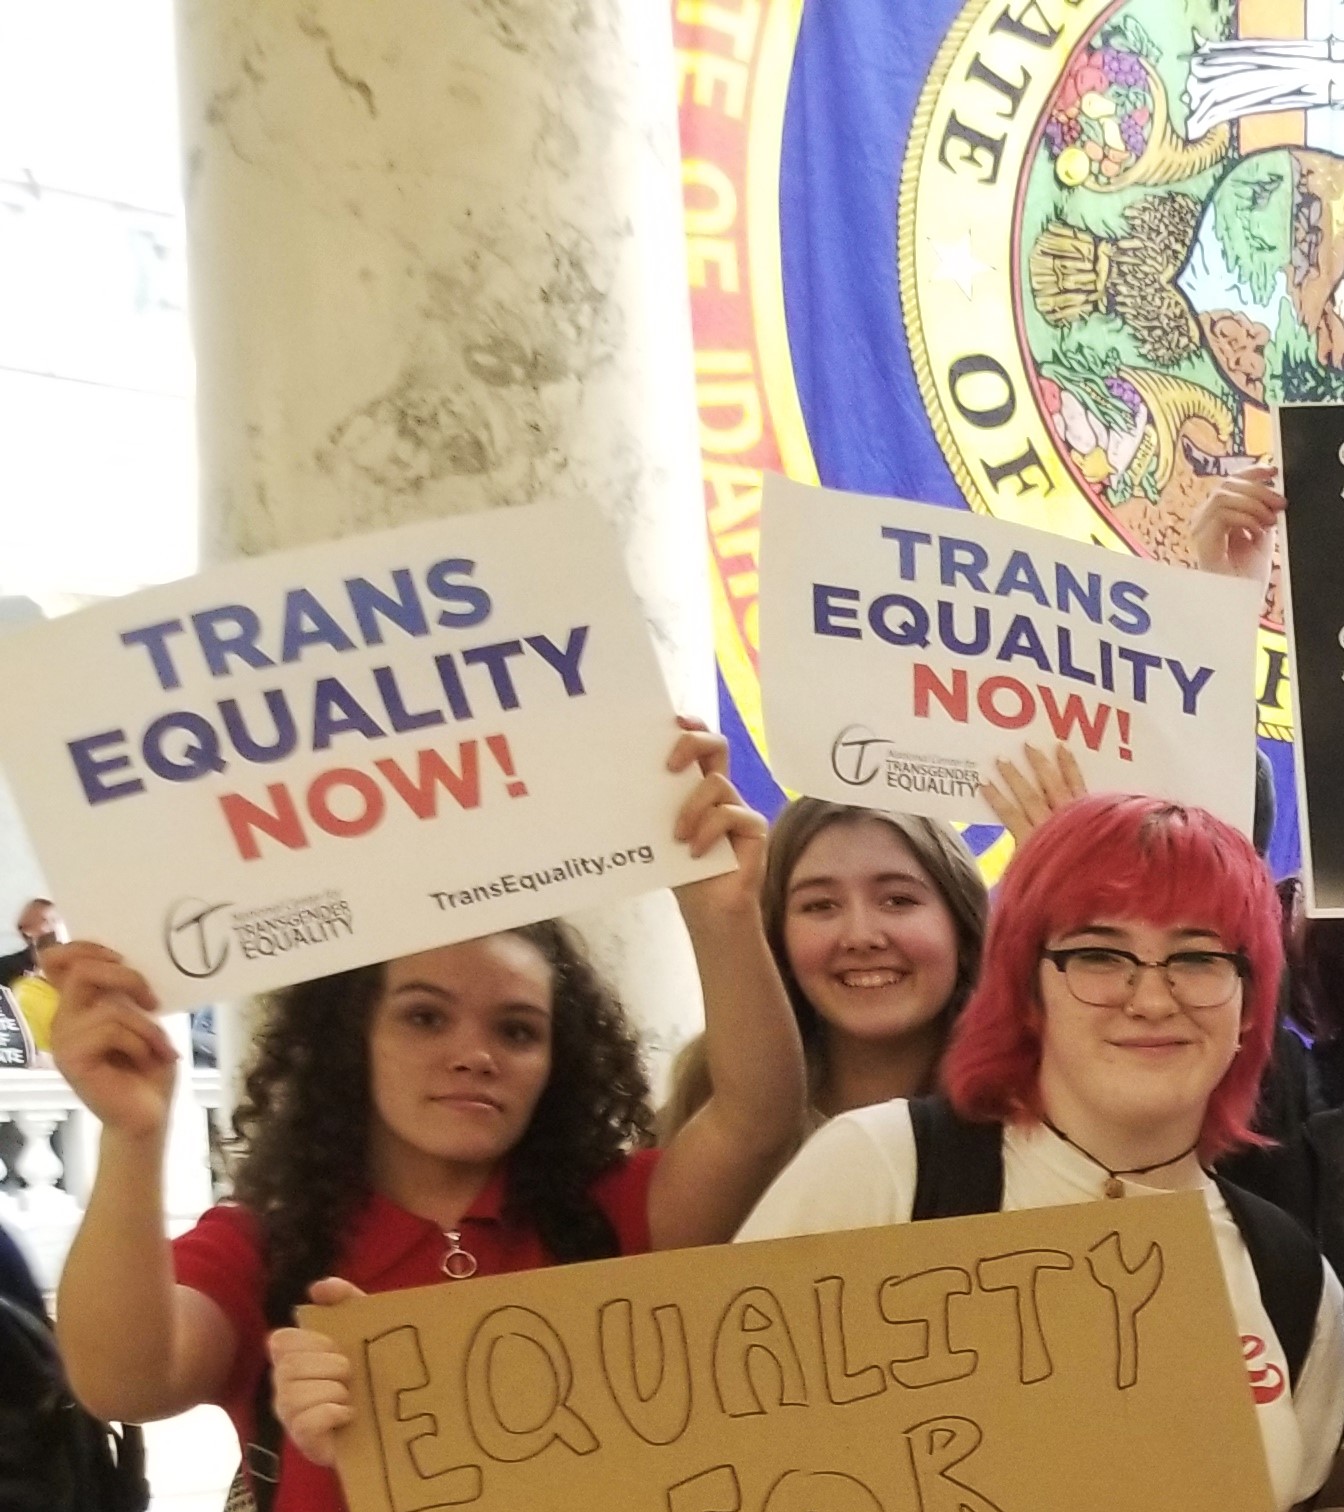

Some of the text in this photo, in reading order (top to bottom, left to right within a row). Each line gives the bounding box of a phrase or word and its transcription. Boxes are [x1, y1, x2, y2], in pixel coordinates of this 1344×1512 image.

[939, 0, 1076, 498] ATE OF
[694, 350, 762, 652] IDAH
[120, 557, 493, 690] TRANS
[881, 525, 1152, 635] TRANS
[813, 582, 1216, 716] EQUALITY
[67, 625, 590, 807] EQUALITY
[886, 759, 980, 783] TRANSGENDER
[914, 662, 1133, 762] NOW!
[219, 734, 528, 861] NOW!
[887, 772, 980, 798] EQUALITY
[430, 843, 656, 912] TransEquality.org
[243, 914, 353, 960] EQUALITY
